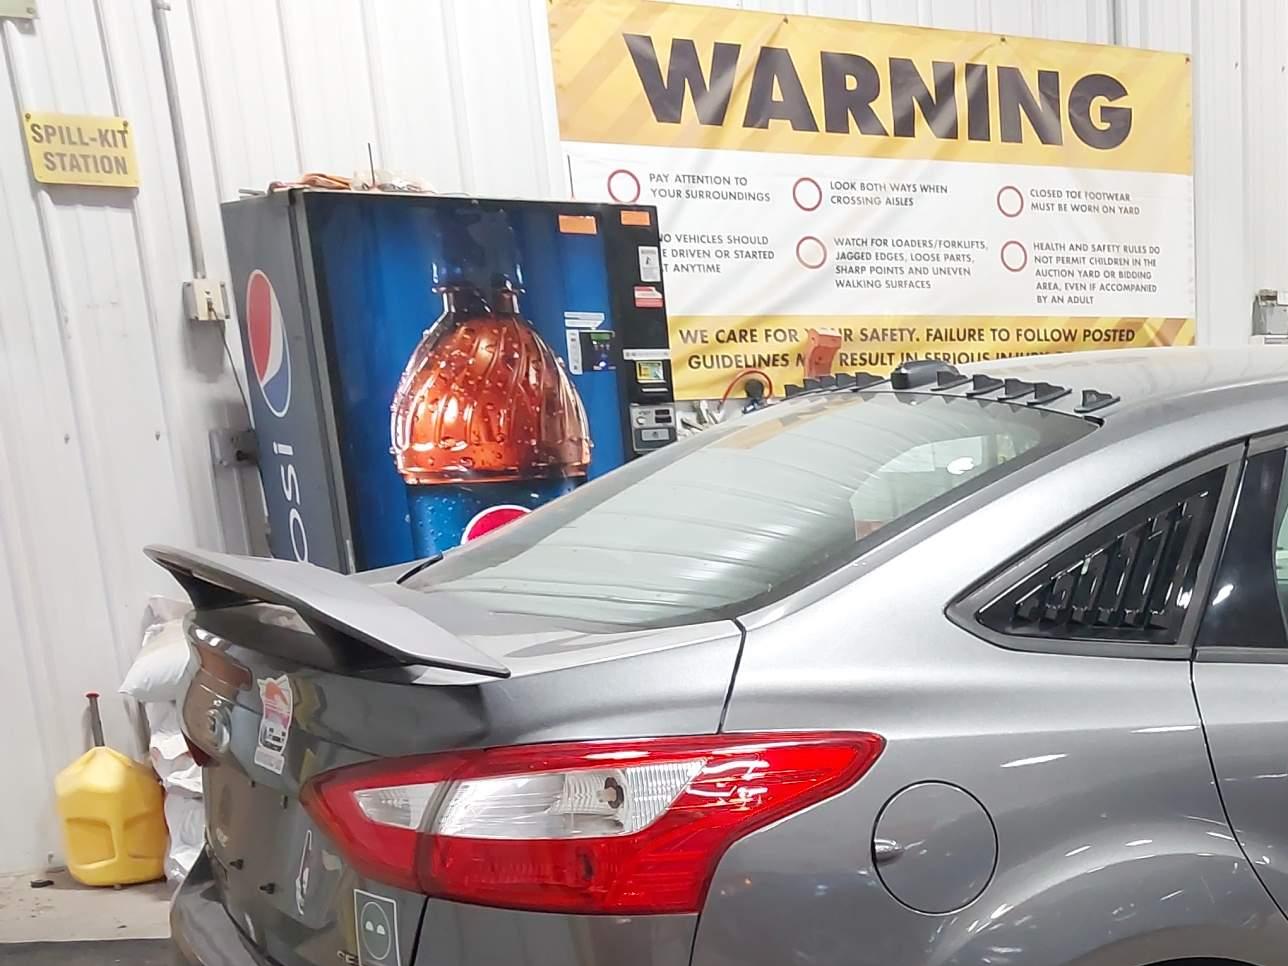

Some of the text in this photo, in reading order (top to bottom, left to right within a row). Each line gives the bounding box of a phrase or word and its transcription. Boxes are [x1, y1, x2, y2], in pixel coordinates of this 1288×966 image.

[622, 33, 1133, 150] WARNING
[30, 123, 128, 148] SPILL-KIT
[43, 151, 128, 175] STATION
[650, 173, 748, 186] PAY ATTENTION TO
[830, 181, 948, 194] LOOK BOTH WAYS WHEN
[650, 188, 771, 202] YOUR SURROUNDINGS
[830, 195, 914, 207] CROSSING AISLES
[1030, 189, 1130, 201] CLOSED TOE FOOTWEAR
[1031, 202, 1140, 215] MUST BE WORN ON YARD
[675, 233, 723, 244] VEHICLES
[727, 234, 769, 245] SHOULD
[834, 238, 868, 247] WATCH
[871, 238, 889, 248] FOR
[671, 249, 711, 259] DRIVEN
[715, 249, 730, 259] OR
[734, 249, 775, 260] STARTED
[1033, 242, 1161, 255] HEALTH AND SAFETY RULES DO
[836, 251, 872, 261] JAGGED
[910, 252, 940, 262] LOOSE
[1034, 255, 1156, 267] NOT PERMIT CHILDREN IN THE
[673, 263, 721, 273] ANYTIME
[835, 265, 971, 276] SHARP POINTS AND UNEVEN
[1035, 269, 1152, 280] AUCTION YARD OR BIDDING
[835, 279, 931, 289] WALKING SURFACES
[1064, 282, 1087, 291] EVEN
[1089, 283, 1096, 291] IF
[1099, 283, 1157, 293] ACCOMPANIED
[1037, 295, 1094, 304] BY AN ADULT
[679, 328, 709, 344] WE
[715, 328, 757, 343] CARE
[764, 328, 800, 343] FOR
[860, 328, 920, 342] SAFETY.
[926, 328, 985, 342] FAILURE
[990, 328, 1010, 342] TO
[1016, 328, 1077, 342] FOLLOW
[1082, 328, 1136, 342] POSTED
[688, 353, 790, 369] GUIDELINES
[839, 352, 896, 366] RESULT
